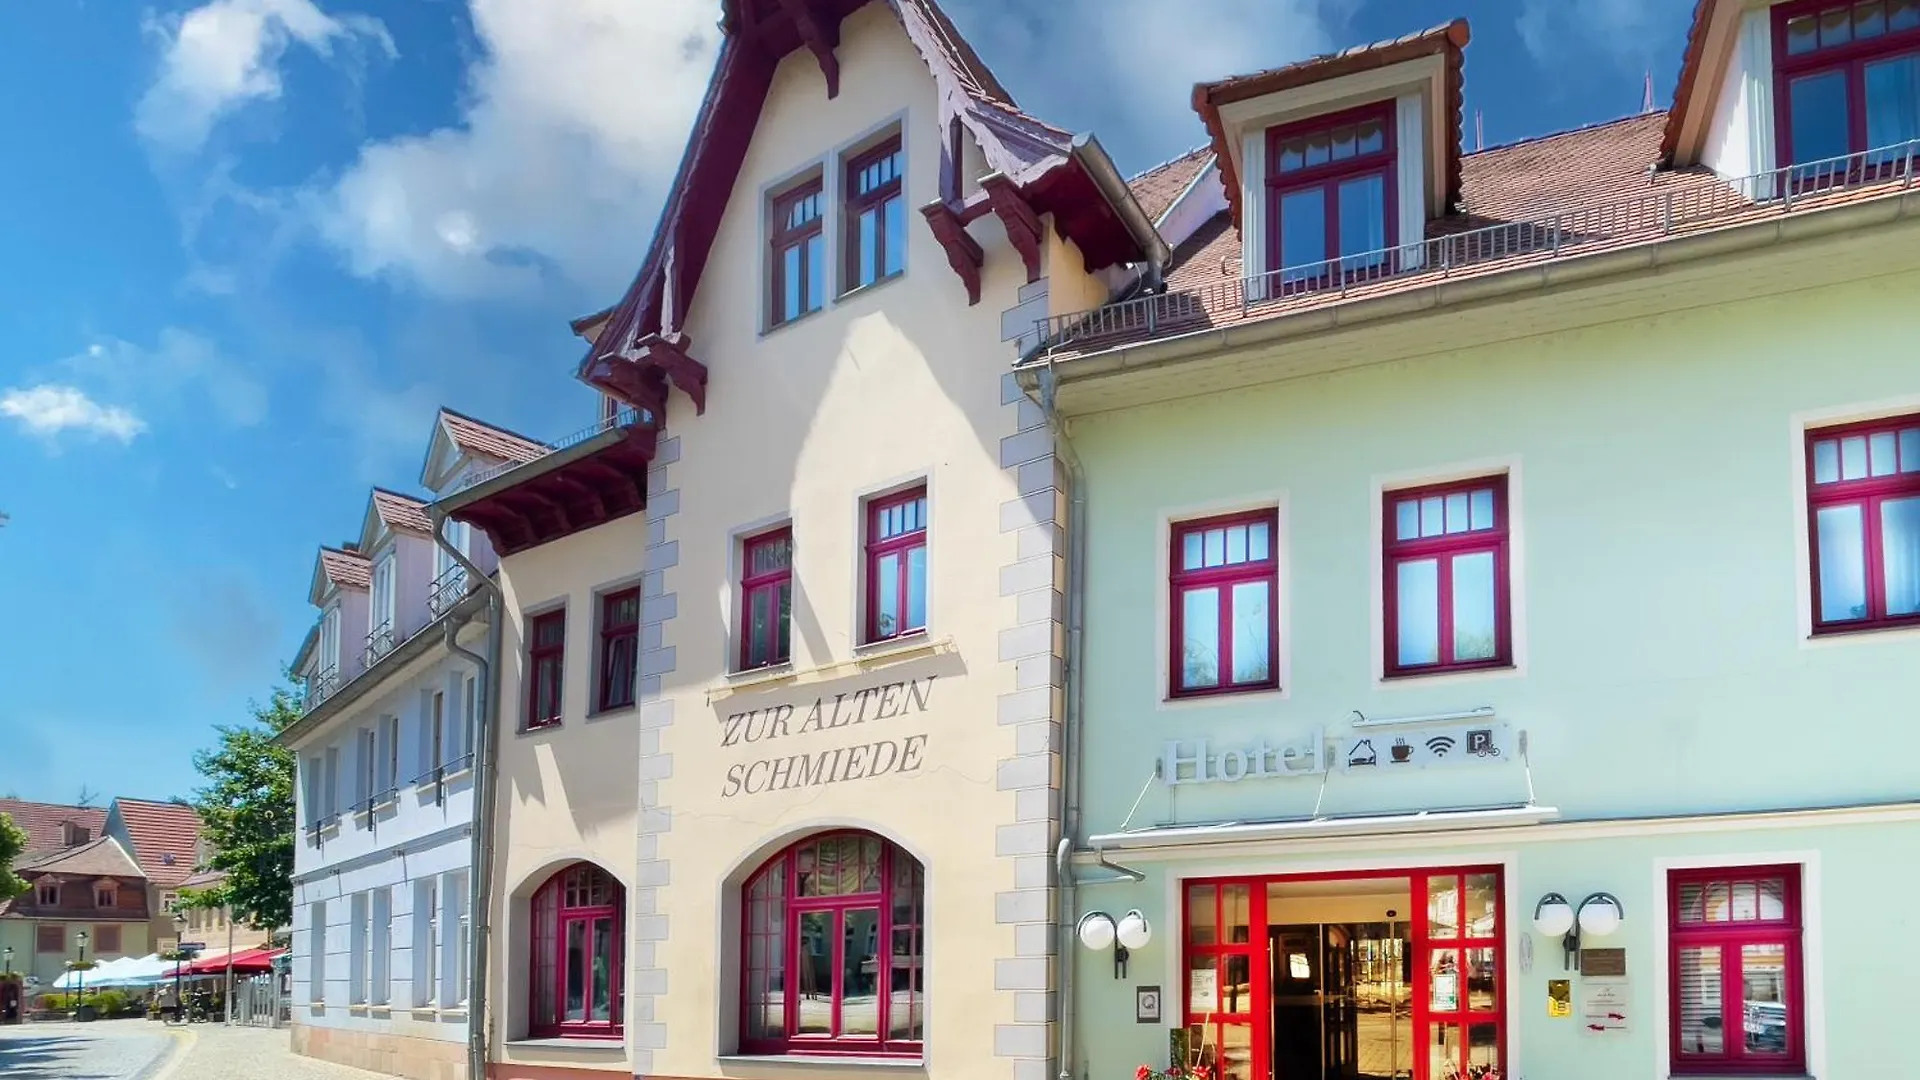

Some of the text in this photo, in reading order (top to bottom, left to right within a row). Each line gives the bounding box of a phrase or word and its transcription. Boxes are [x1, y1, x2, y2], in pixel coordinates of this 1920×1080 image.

[720, 675, 938, 748] ZUR ALTEN
[1474, 734, 1486, 750] P
[721, 734, 928, 798] SCHMIEDE
[1163, 724, 1326, 787] Hotel
